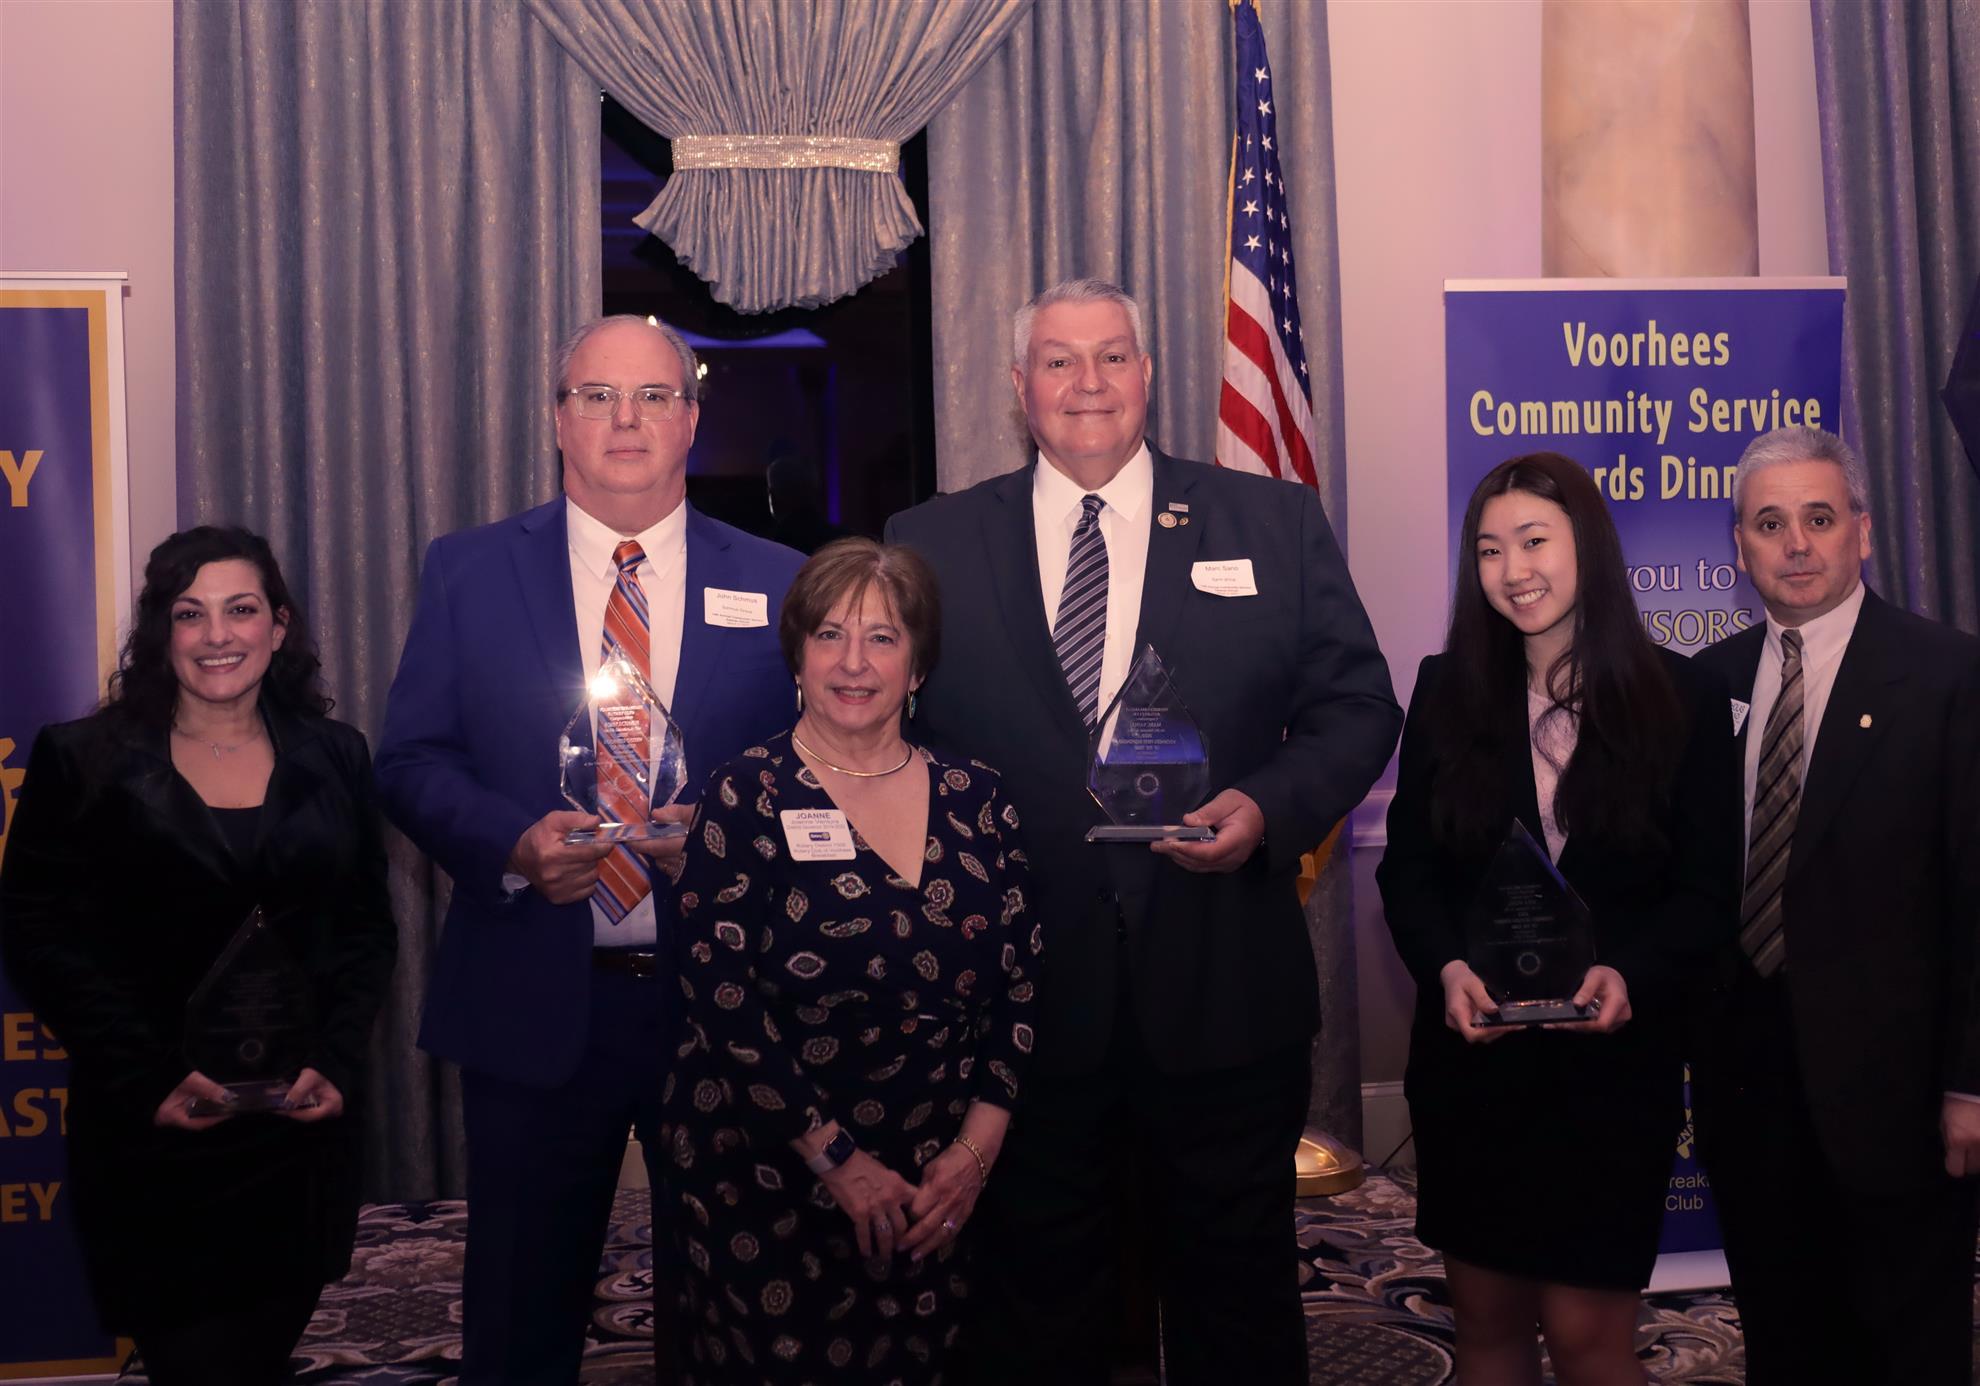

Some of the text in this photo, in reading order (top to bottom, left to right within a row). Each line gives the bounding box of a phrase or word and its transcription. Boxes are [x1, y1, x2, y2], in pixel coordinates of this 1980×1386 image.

[1563, 320, 1730, 367] Voorhees
[1469, 387, 1821, 445] Community Service
[1594, 454, 1738, 500] rds Dinn
[1627, 558, 1737, 591] ou to
[1643, 609, 1752, 646] SORS
[1669, 1172, 1710, 1188] reak
[1665, 1194, 1704, 1211] Club
